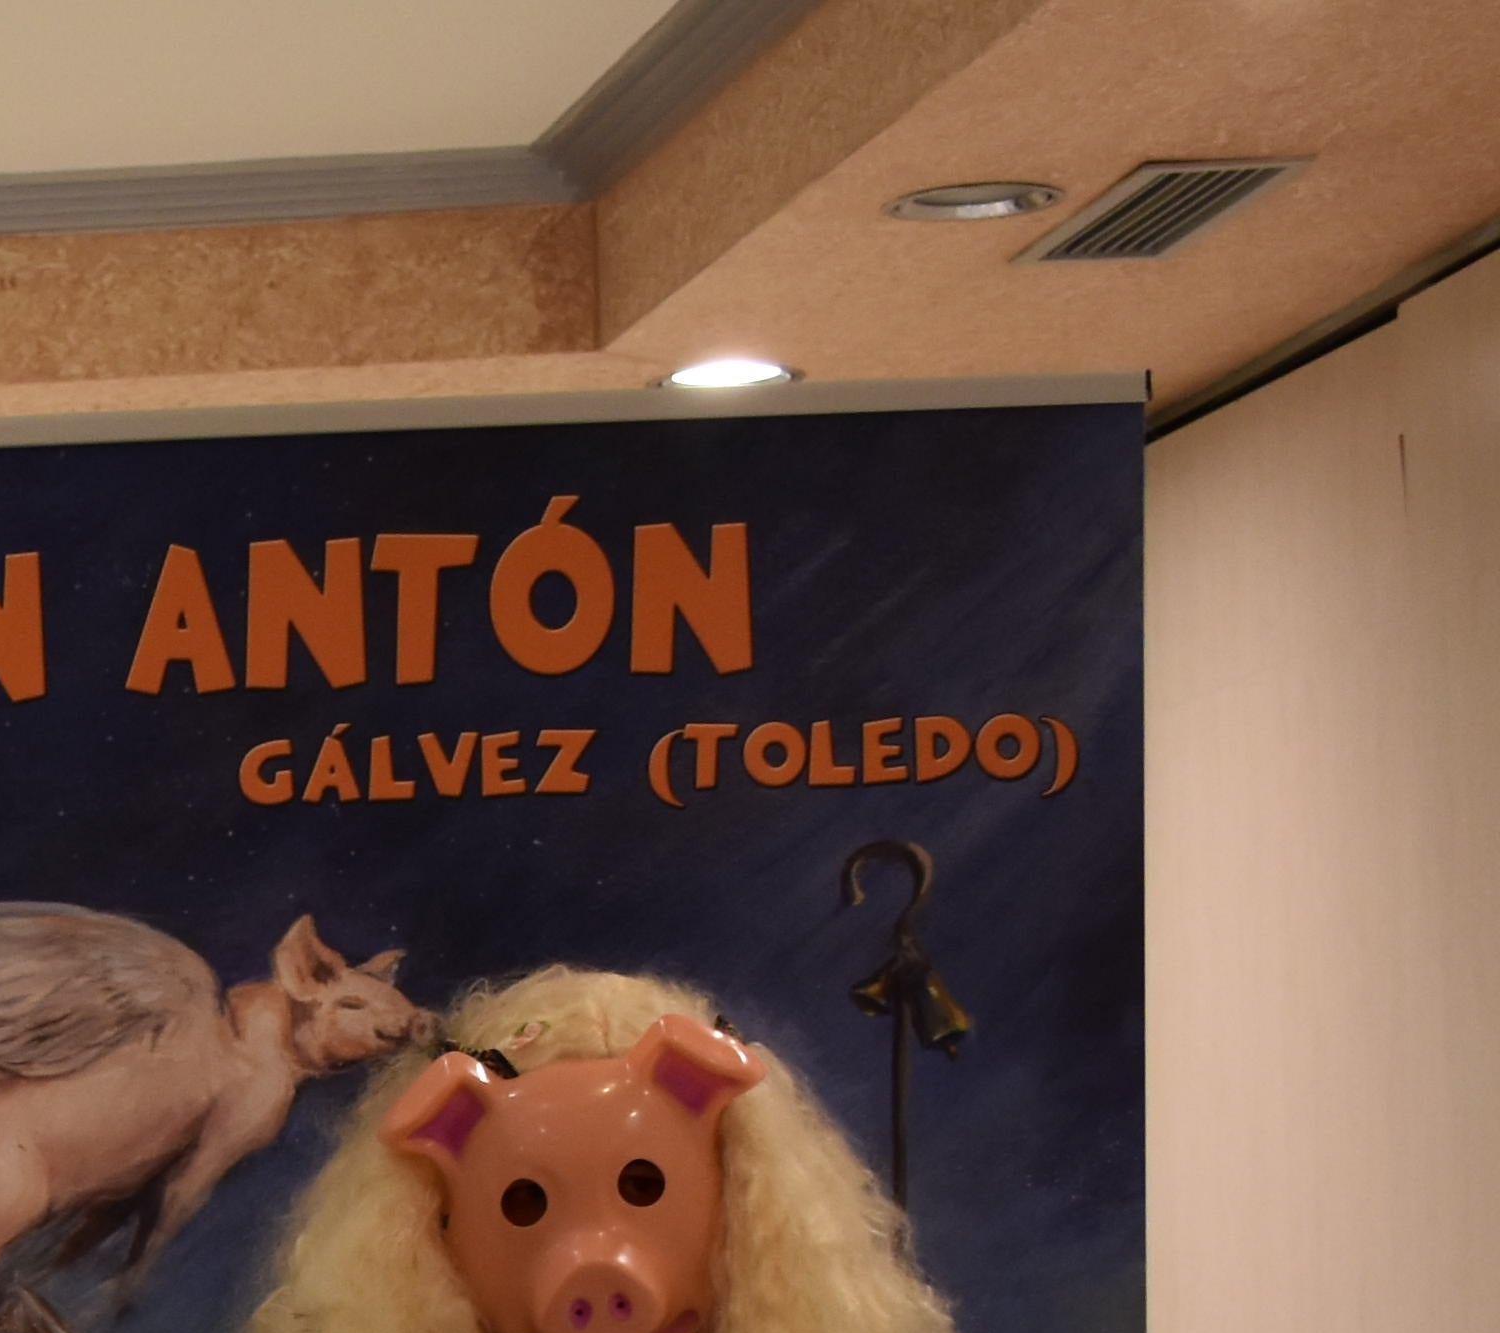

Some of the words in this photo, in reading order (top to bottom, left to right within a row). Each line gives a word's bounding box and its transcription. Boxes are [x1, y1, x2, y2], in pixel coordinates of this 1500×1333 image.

[125, 495, 752, 694] ANTÓN
[239, 722, 594, 804] GÁLVEZ
[647, 712, 1080, 808] (TOLEDO)
